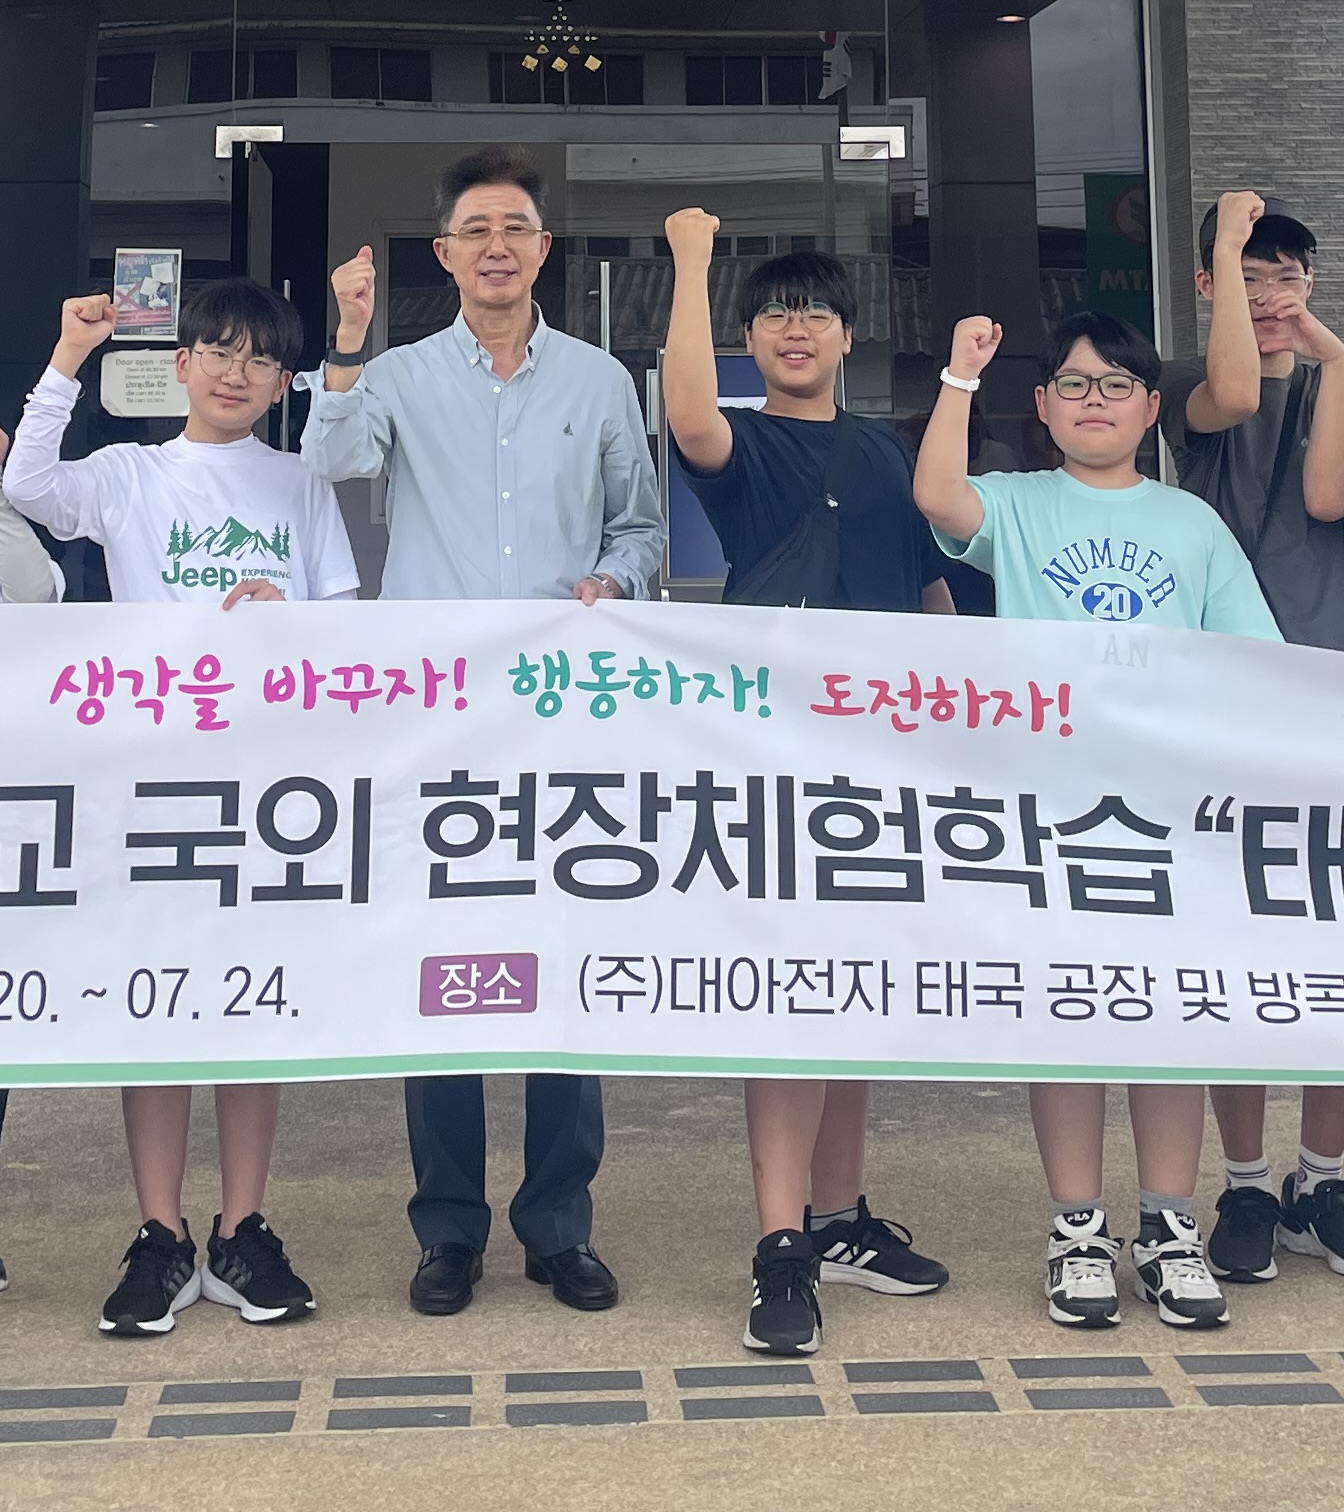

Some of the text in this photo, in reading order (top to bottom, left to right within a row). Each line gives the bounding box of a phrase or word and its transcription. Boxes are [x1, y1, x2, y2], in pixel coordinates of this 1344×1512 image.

[161, 561, 238, 592] Jeep
[1041, 538, 1176, 608] NUMBER
[1092, 585, 1132, 620] 20
[49, 650, 1074, 738] 생각을 바꾸자! 행동하자! 도전하자!
[125, 776, 373, 908] 국외
[419, 769, 1174, 917] 현장체험학습
[127, 967, 200, 1020] 07.
[223, 965, 299, 1018] 24.
[438, 961, 523, 1009] 장소
[578, 954, 896, 1017] (주)대아전자
[915, 960, 1025, 1019] 태국
[1046, 963, 1157, 1022] 공장
[1175, 968, 1231, 1023] 및
[1067, 1212, 1091, 1223] FILA
